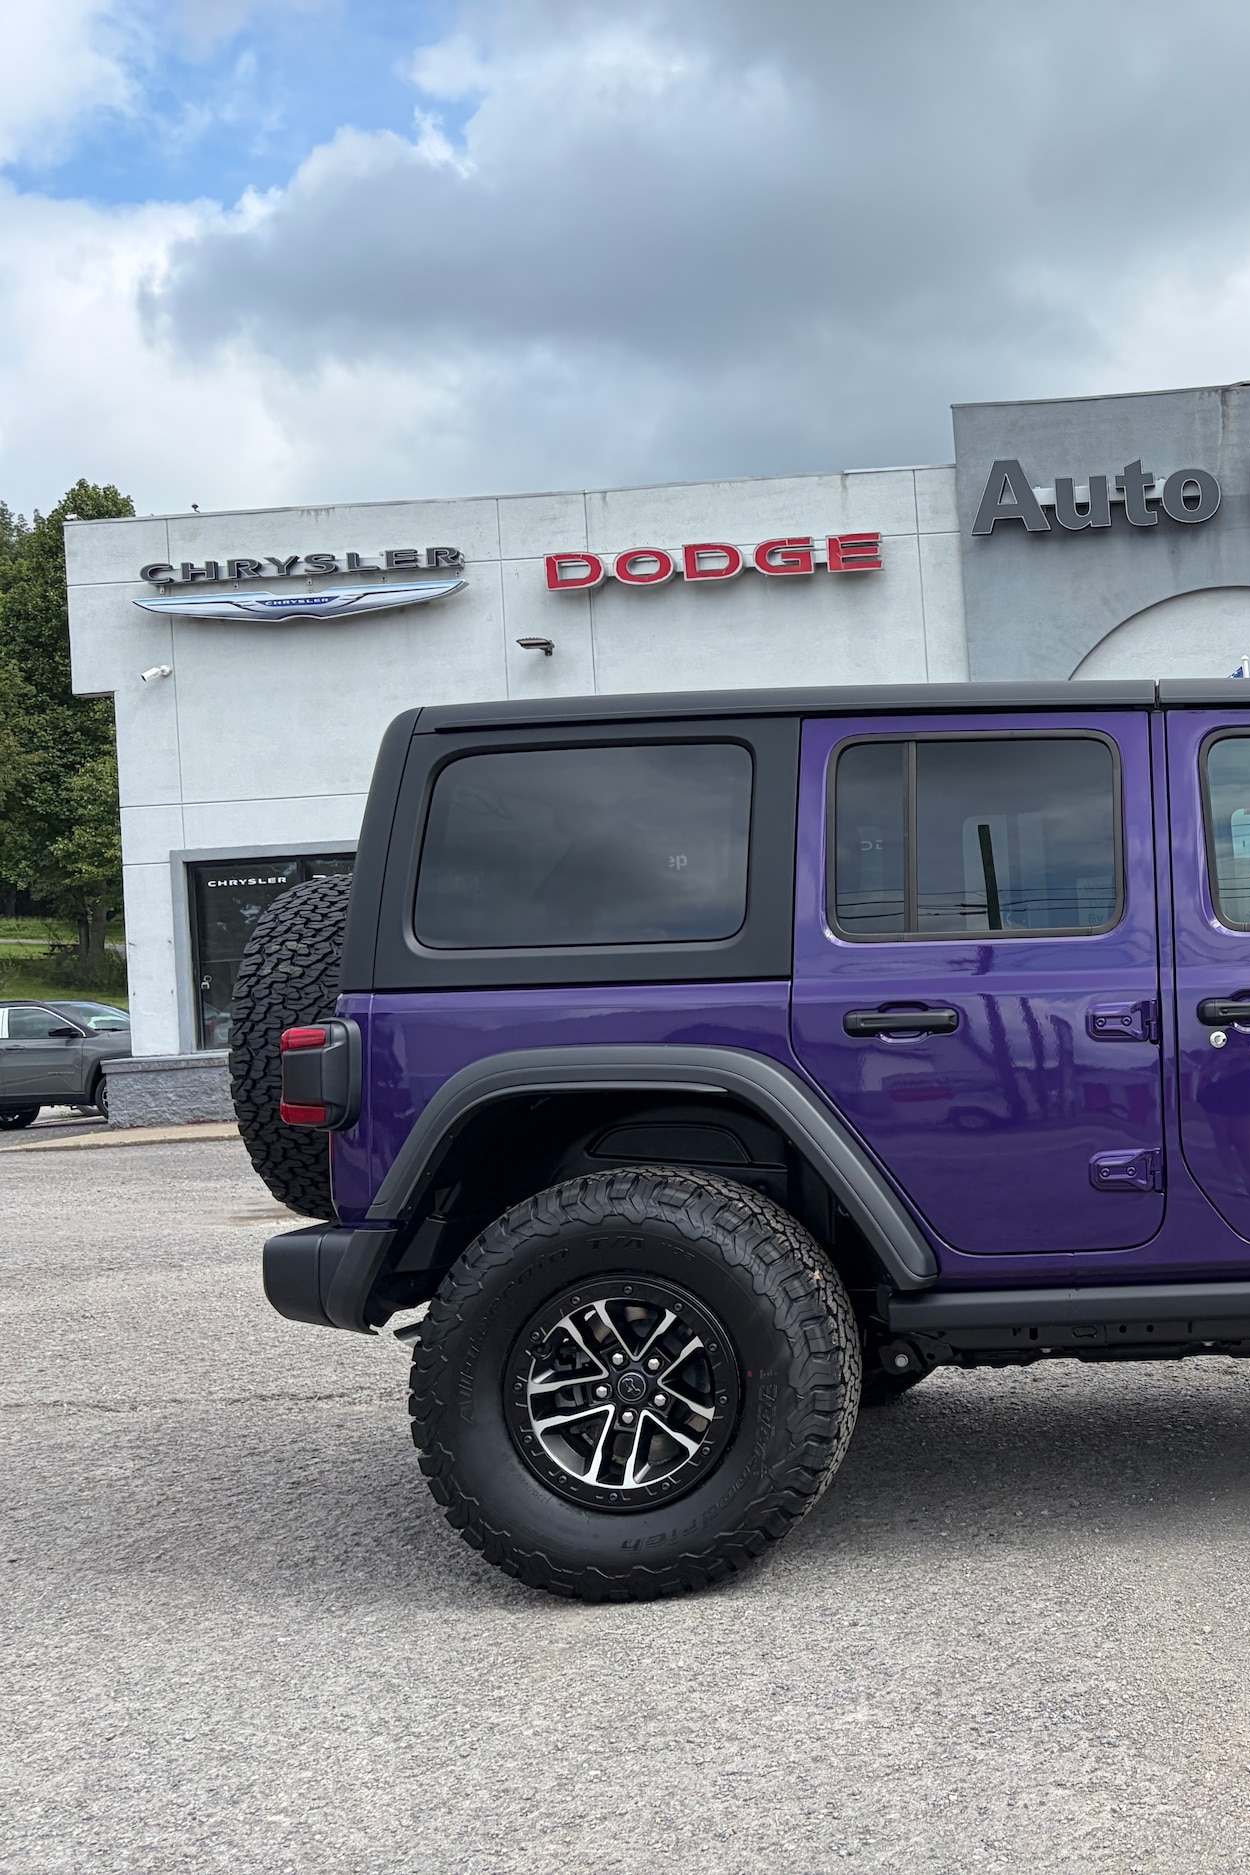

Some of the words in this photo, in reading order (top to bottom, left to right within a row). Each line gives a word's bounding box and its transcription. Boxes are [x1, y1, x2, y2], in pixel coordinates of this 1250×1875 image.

[970, 458, 1221, 536] Auto
[140, 547, 463, 584] CHRYSLER
[544, 532, 883, 591] DODGE
[265, 598, 328, 606] CHRYSLER
[207, 876, 288, 888] CHRYSLER
